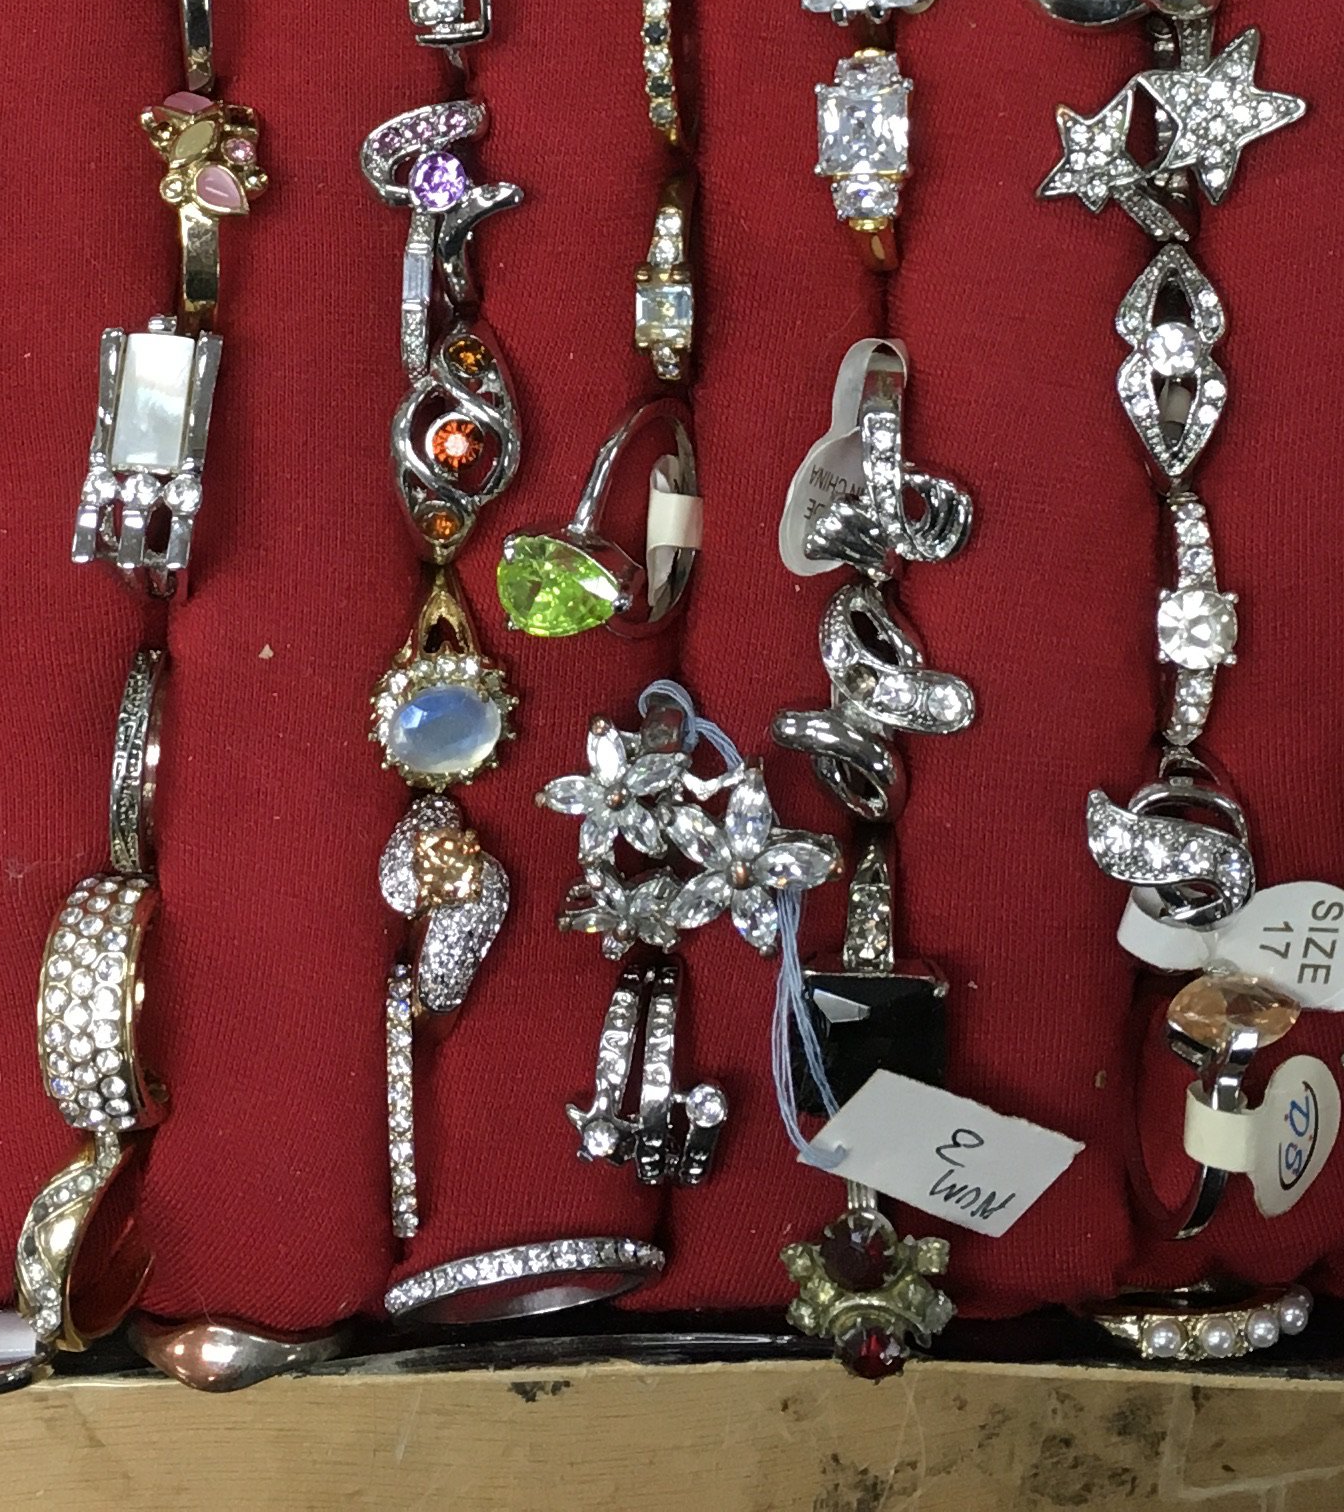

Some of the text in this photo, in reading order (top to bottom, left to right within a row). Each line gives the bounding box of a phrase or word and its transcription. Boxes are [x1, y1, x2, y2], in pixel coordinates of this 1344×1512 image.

[808, 464, 848, 495] CHINA
[1259, 921, 1294, 959] 17
[1297, 900, 1344, 984] SIZE
[1285, 1095, 1310, 1176] DS
